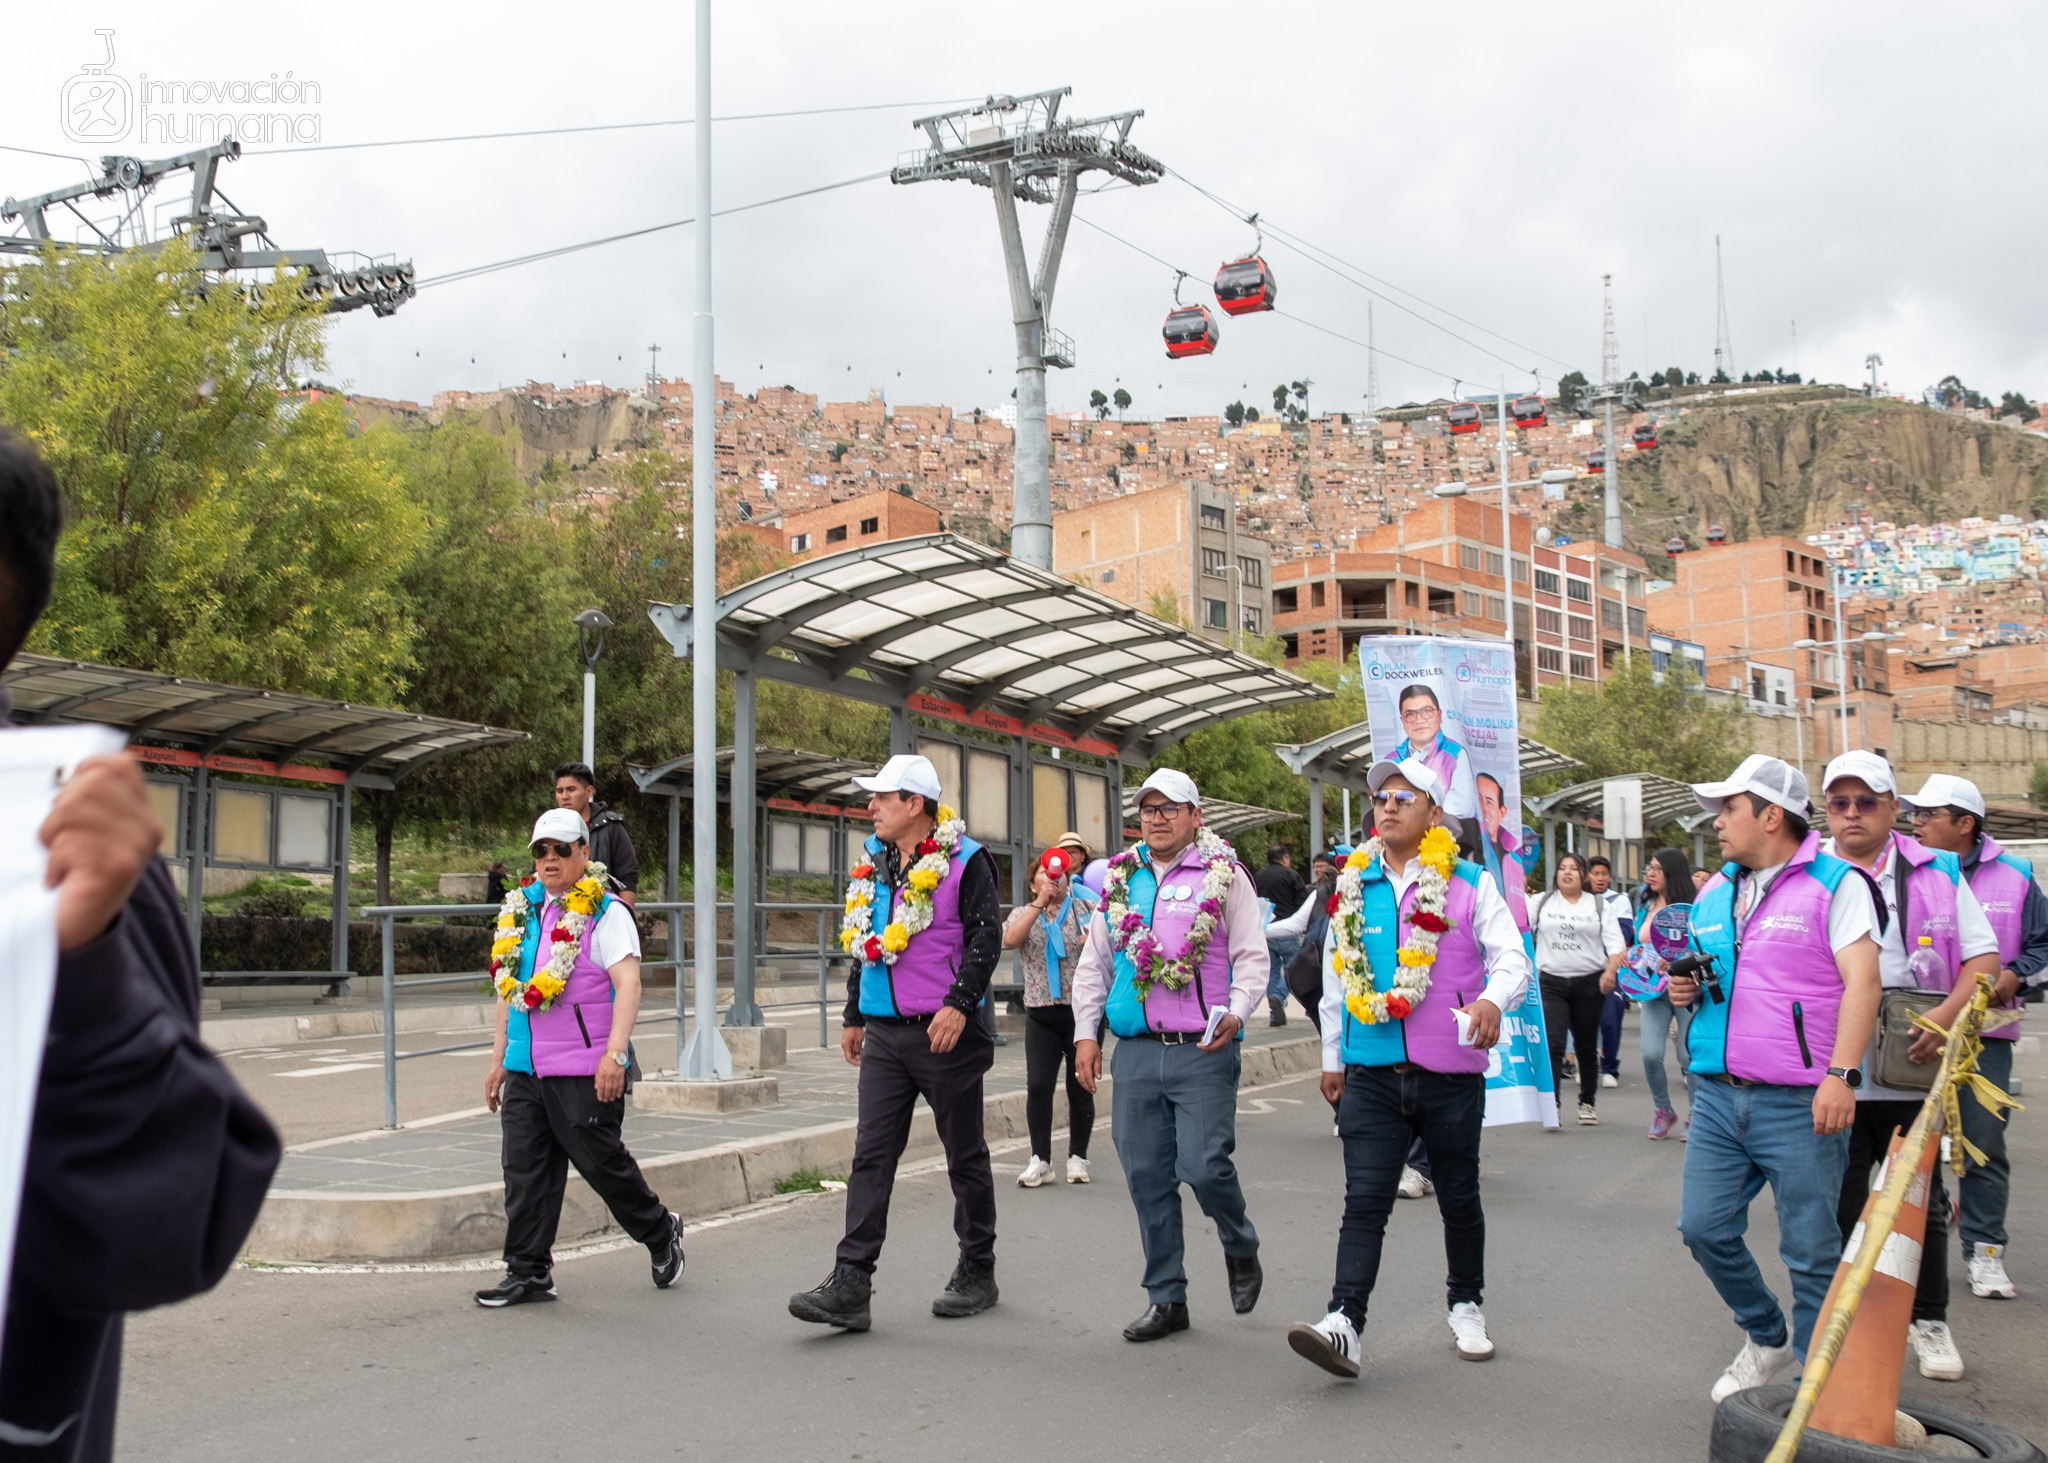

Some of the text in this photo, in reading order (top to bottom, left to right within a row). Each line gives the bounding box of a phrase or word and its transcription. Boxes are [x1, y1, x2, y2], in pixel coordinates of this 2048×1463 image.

[1384, 662, 1407, 671] PLAN
[1385, 667, 1444, 680] DOCKWEILER
[920, 698, 952, 715] Estación
[1476, 717, 1515, 729] MOLINA
[143, 749, 265, 773] Ajayuni Cementerio
[1560, 922, 1575, 931] ON
[1558, 931, 1577, 941] THE
[1551, 941, 1583, 952] BLOCK
